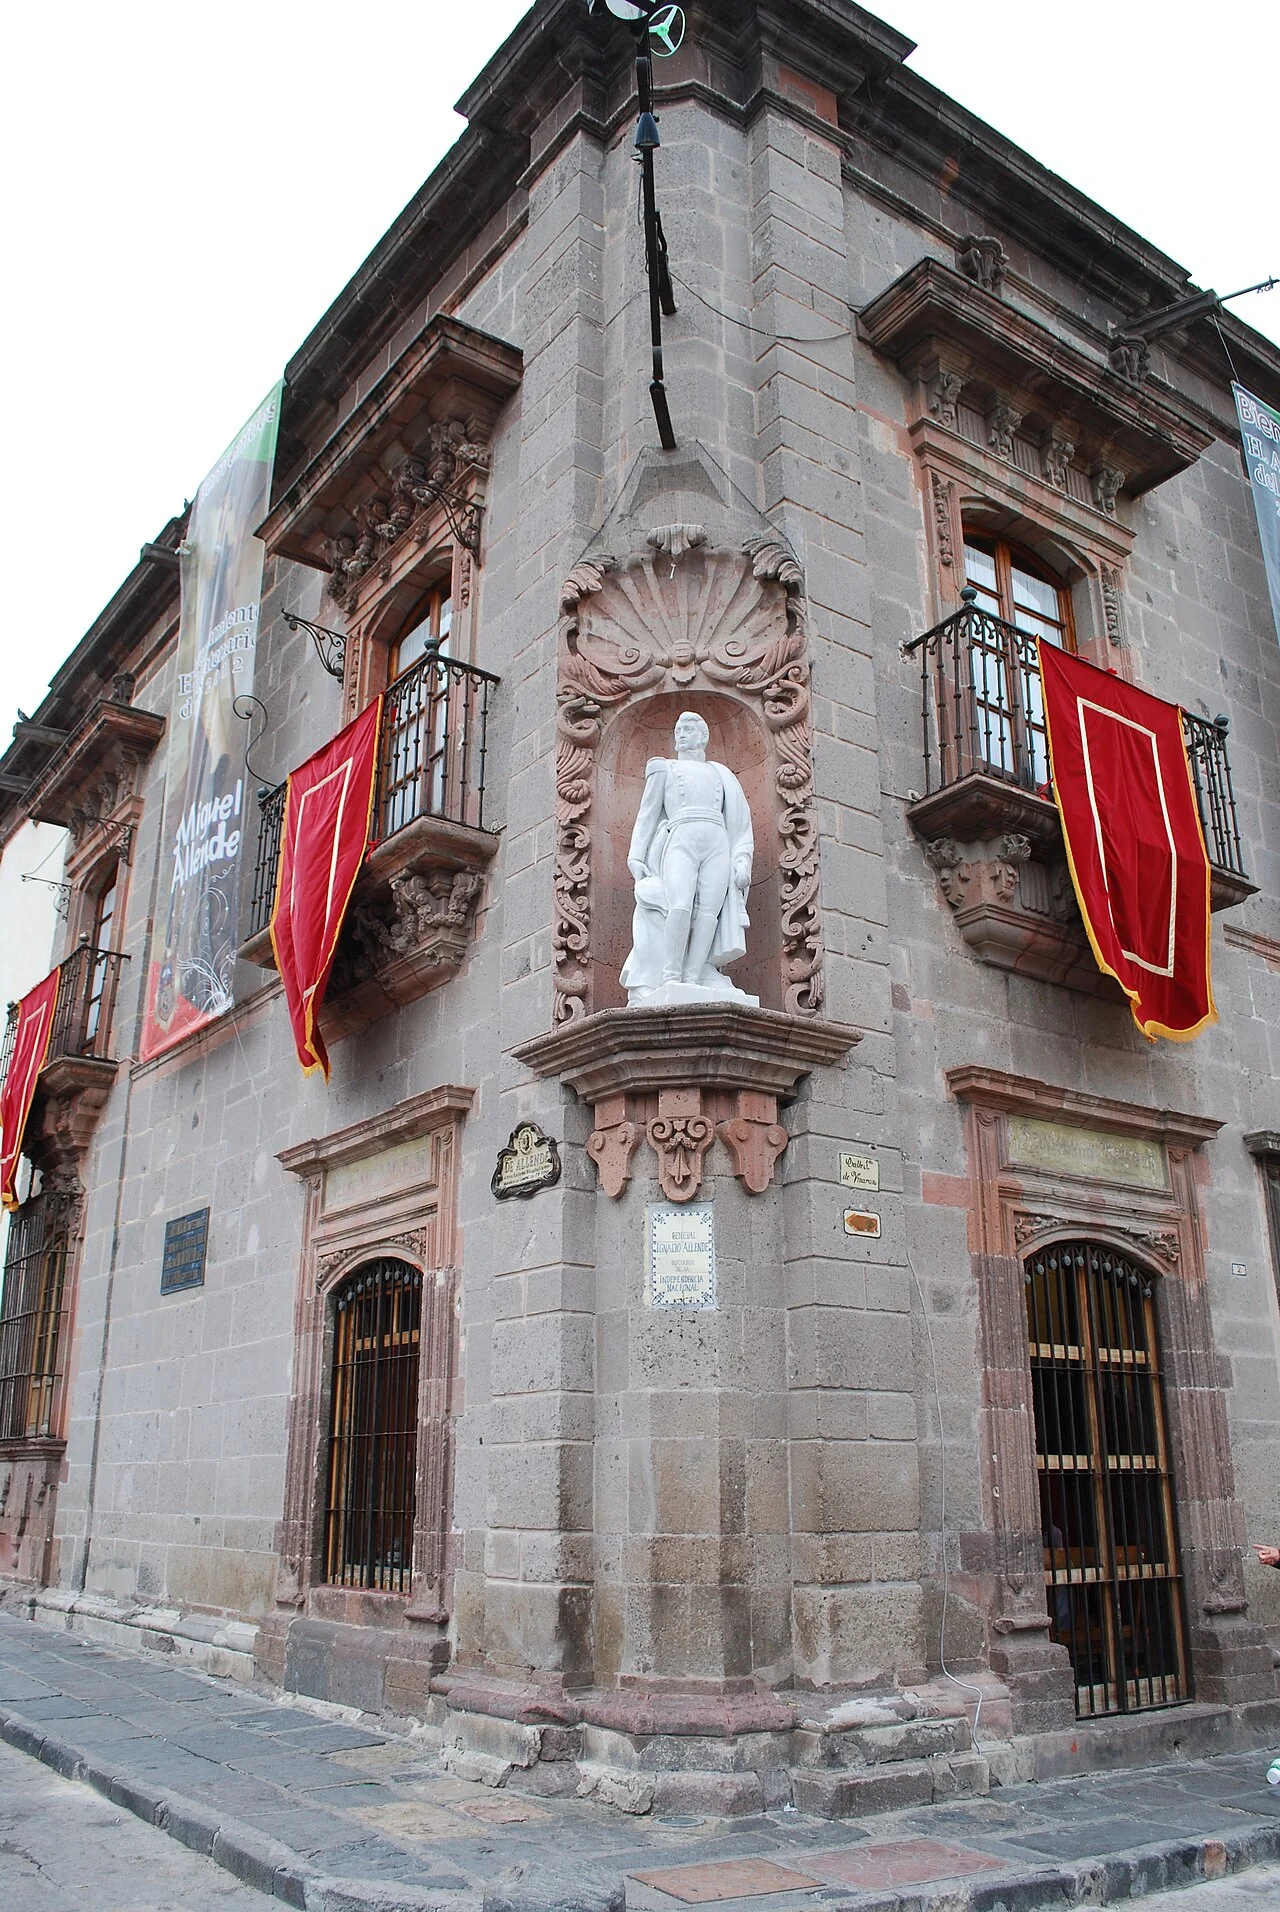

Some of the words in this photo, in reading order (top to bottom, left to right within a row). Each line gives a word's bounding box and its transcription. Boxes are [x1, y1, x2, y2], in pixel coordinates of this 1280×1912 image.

[176, 779, 242, 846] Miguel
[171, 821, 241, 894] Allende
[516, 1151, 550, 1172] ALLENDE
[660, 1275, 704, 1284] INDEPENDENCIA
[666, 1283, 699, 1292] NACIONAL
